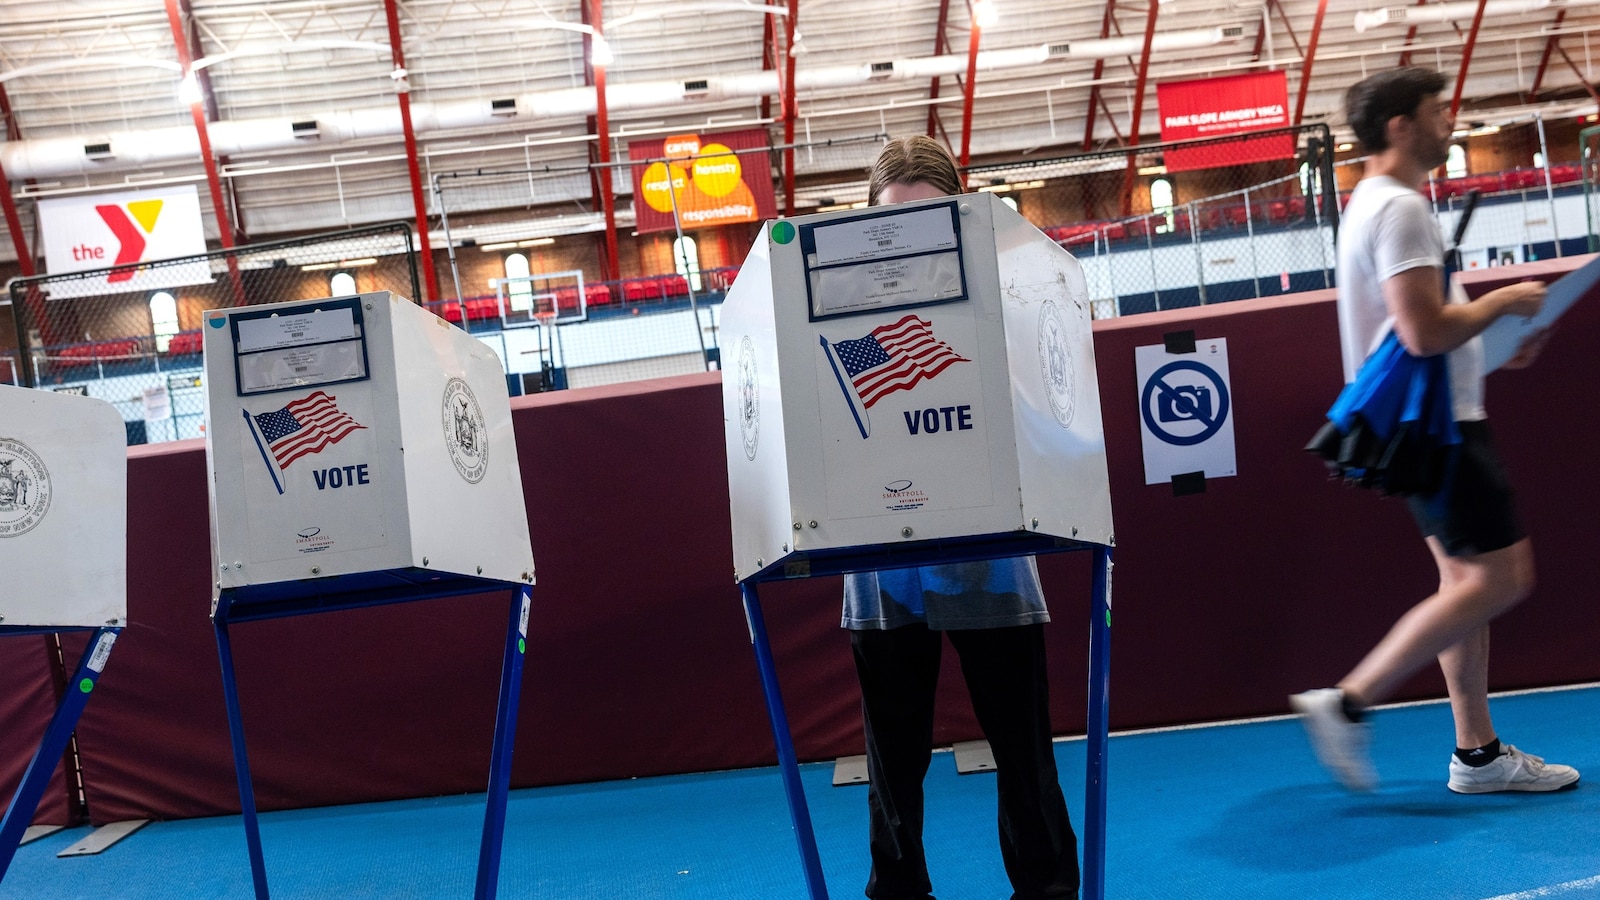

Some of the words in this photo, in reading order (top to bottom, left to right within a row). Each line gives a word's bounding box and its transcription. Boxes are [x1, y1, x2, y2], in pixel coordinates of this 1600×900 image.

[1165, 116, 1190, 128] PARK
[1190, 112, 1218, 125] SLOPE
[1219, 108, 1256, 122] ARMORY
[1256, 105, 1284, 117] YMCA
[666, 141, 698, 154] caring
[696, 163, 736, 175] honesty
[683, 205, 753, 222] responsibility
[72, 244, 104, 261] the
[903, 404, 973, 436] VOTE
[6, 444, 46, 482] ELECTIONS
[312, 463, 370, 491] VOTE
[883, 490, 924, 499] SMARTPOLL
[31, 492, 48, 518] YORK
[296, 535, 330, 544] SMARTPOLL
